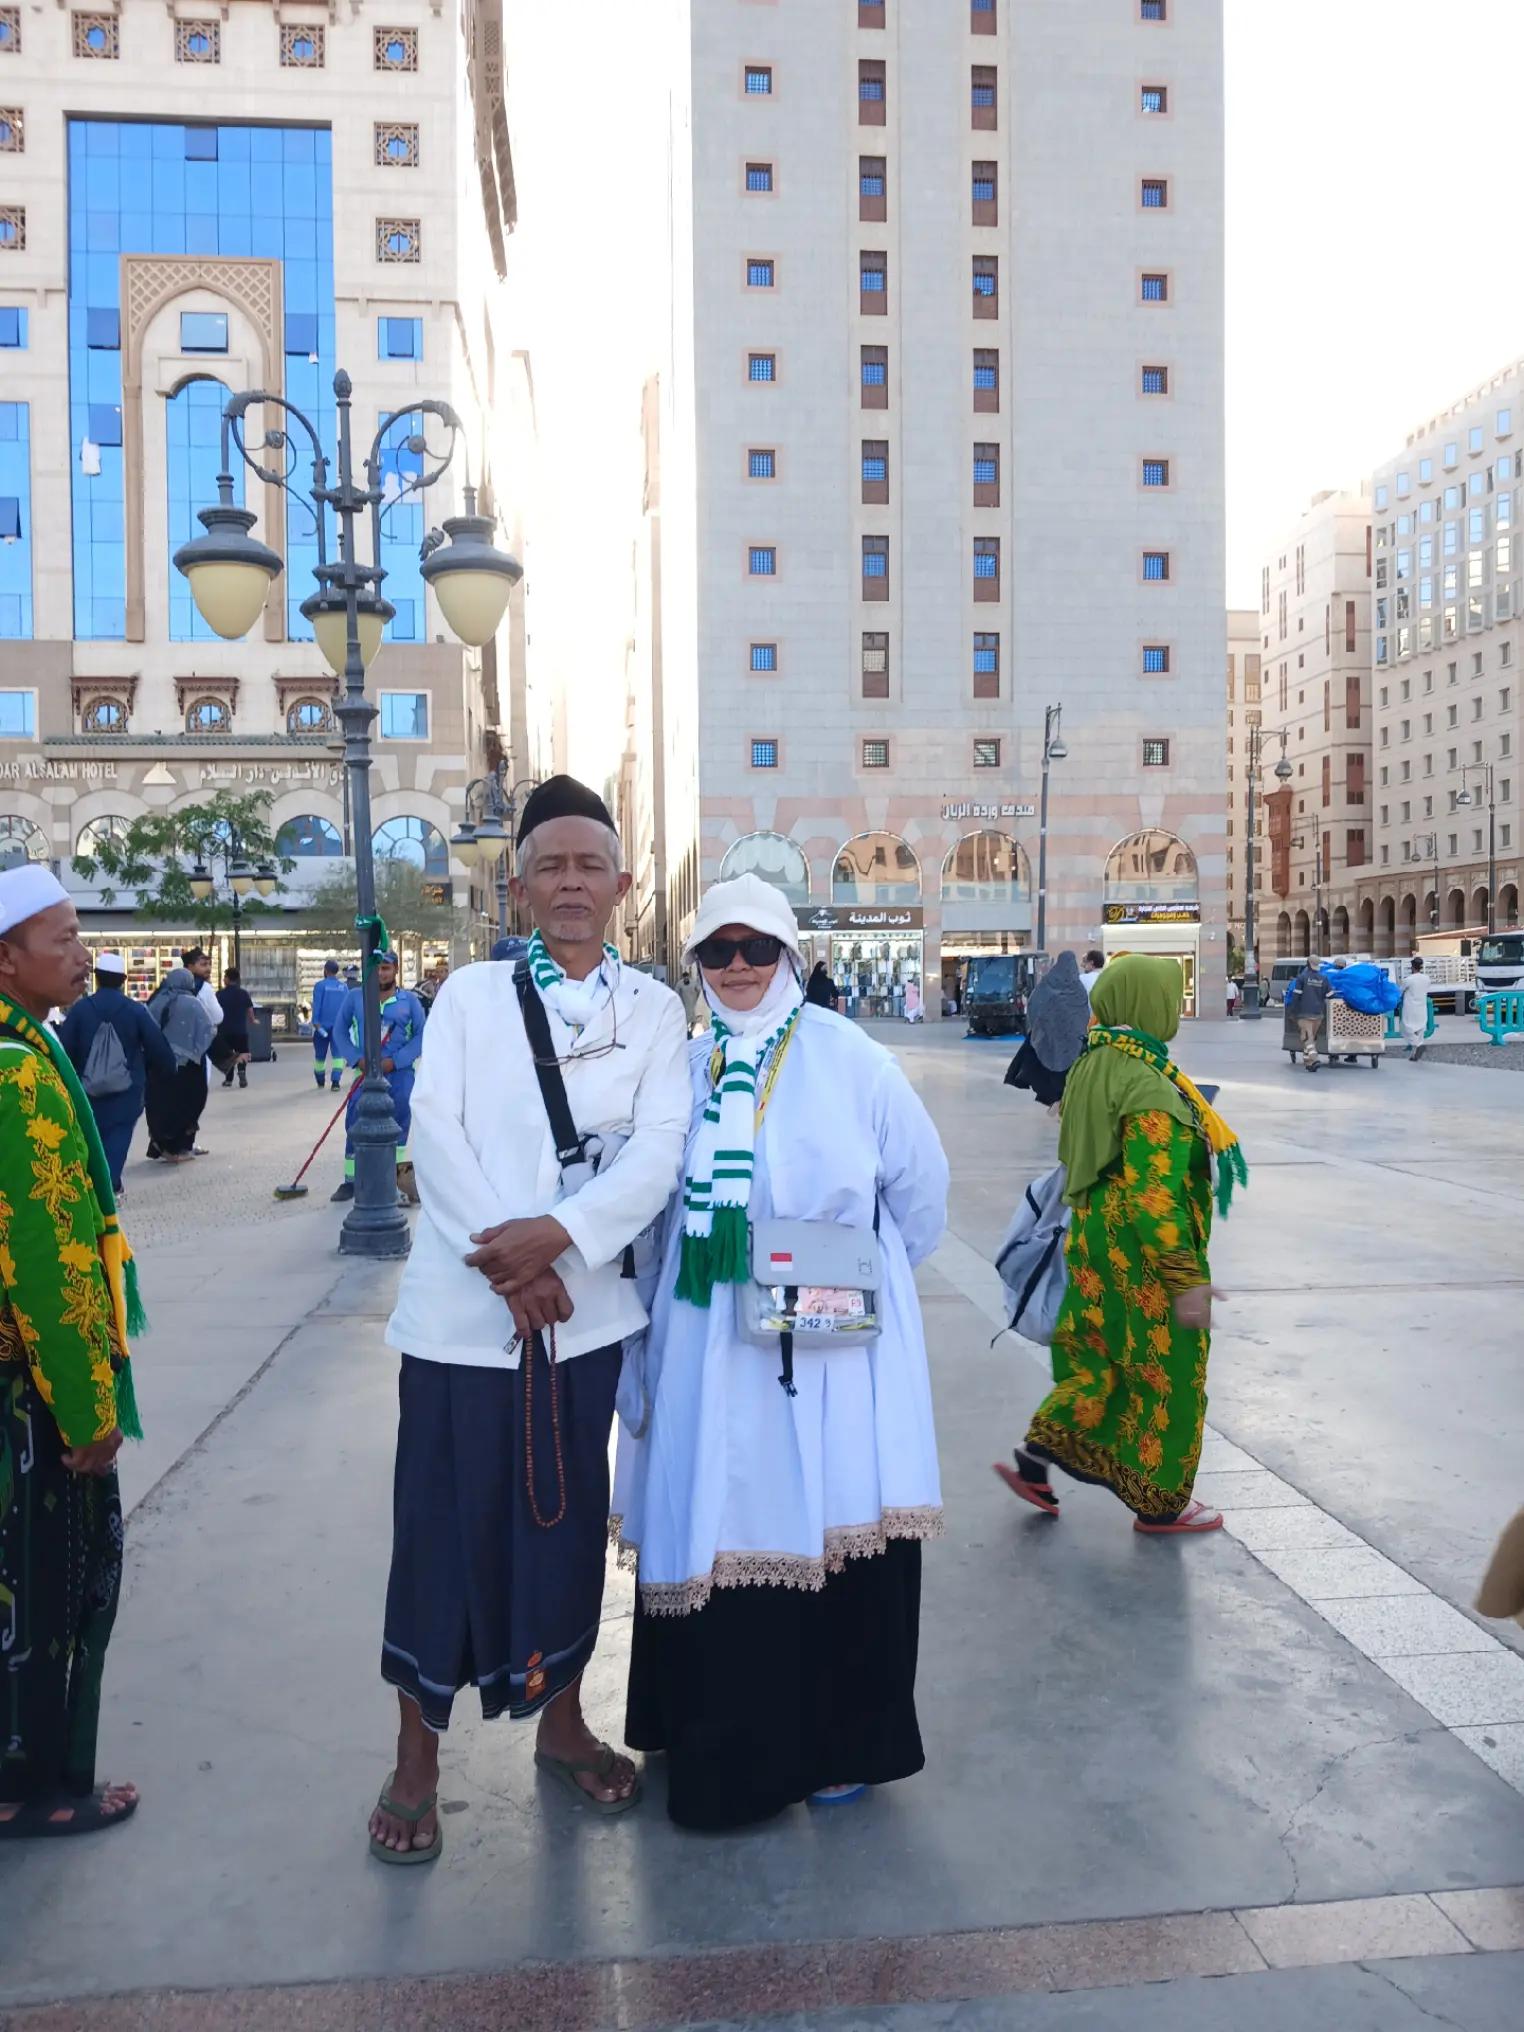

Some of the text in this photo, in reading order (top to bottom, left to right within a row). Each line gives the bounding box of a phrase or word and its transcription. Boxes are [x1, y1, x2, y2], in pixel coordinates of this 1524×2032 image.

[82, 761, 118, 779] HOTEL
[200, 761, 242, 785] السلام
[245, 762, 265, 784] دار
[848, 909, 912, 925] ثوب المدينة
[800, 1317, 821, 1329] 342
